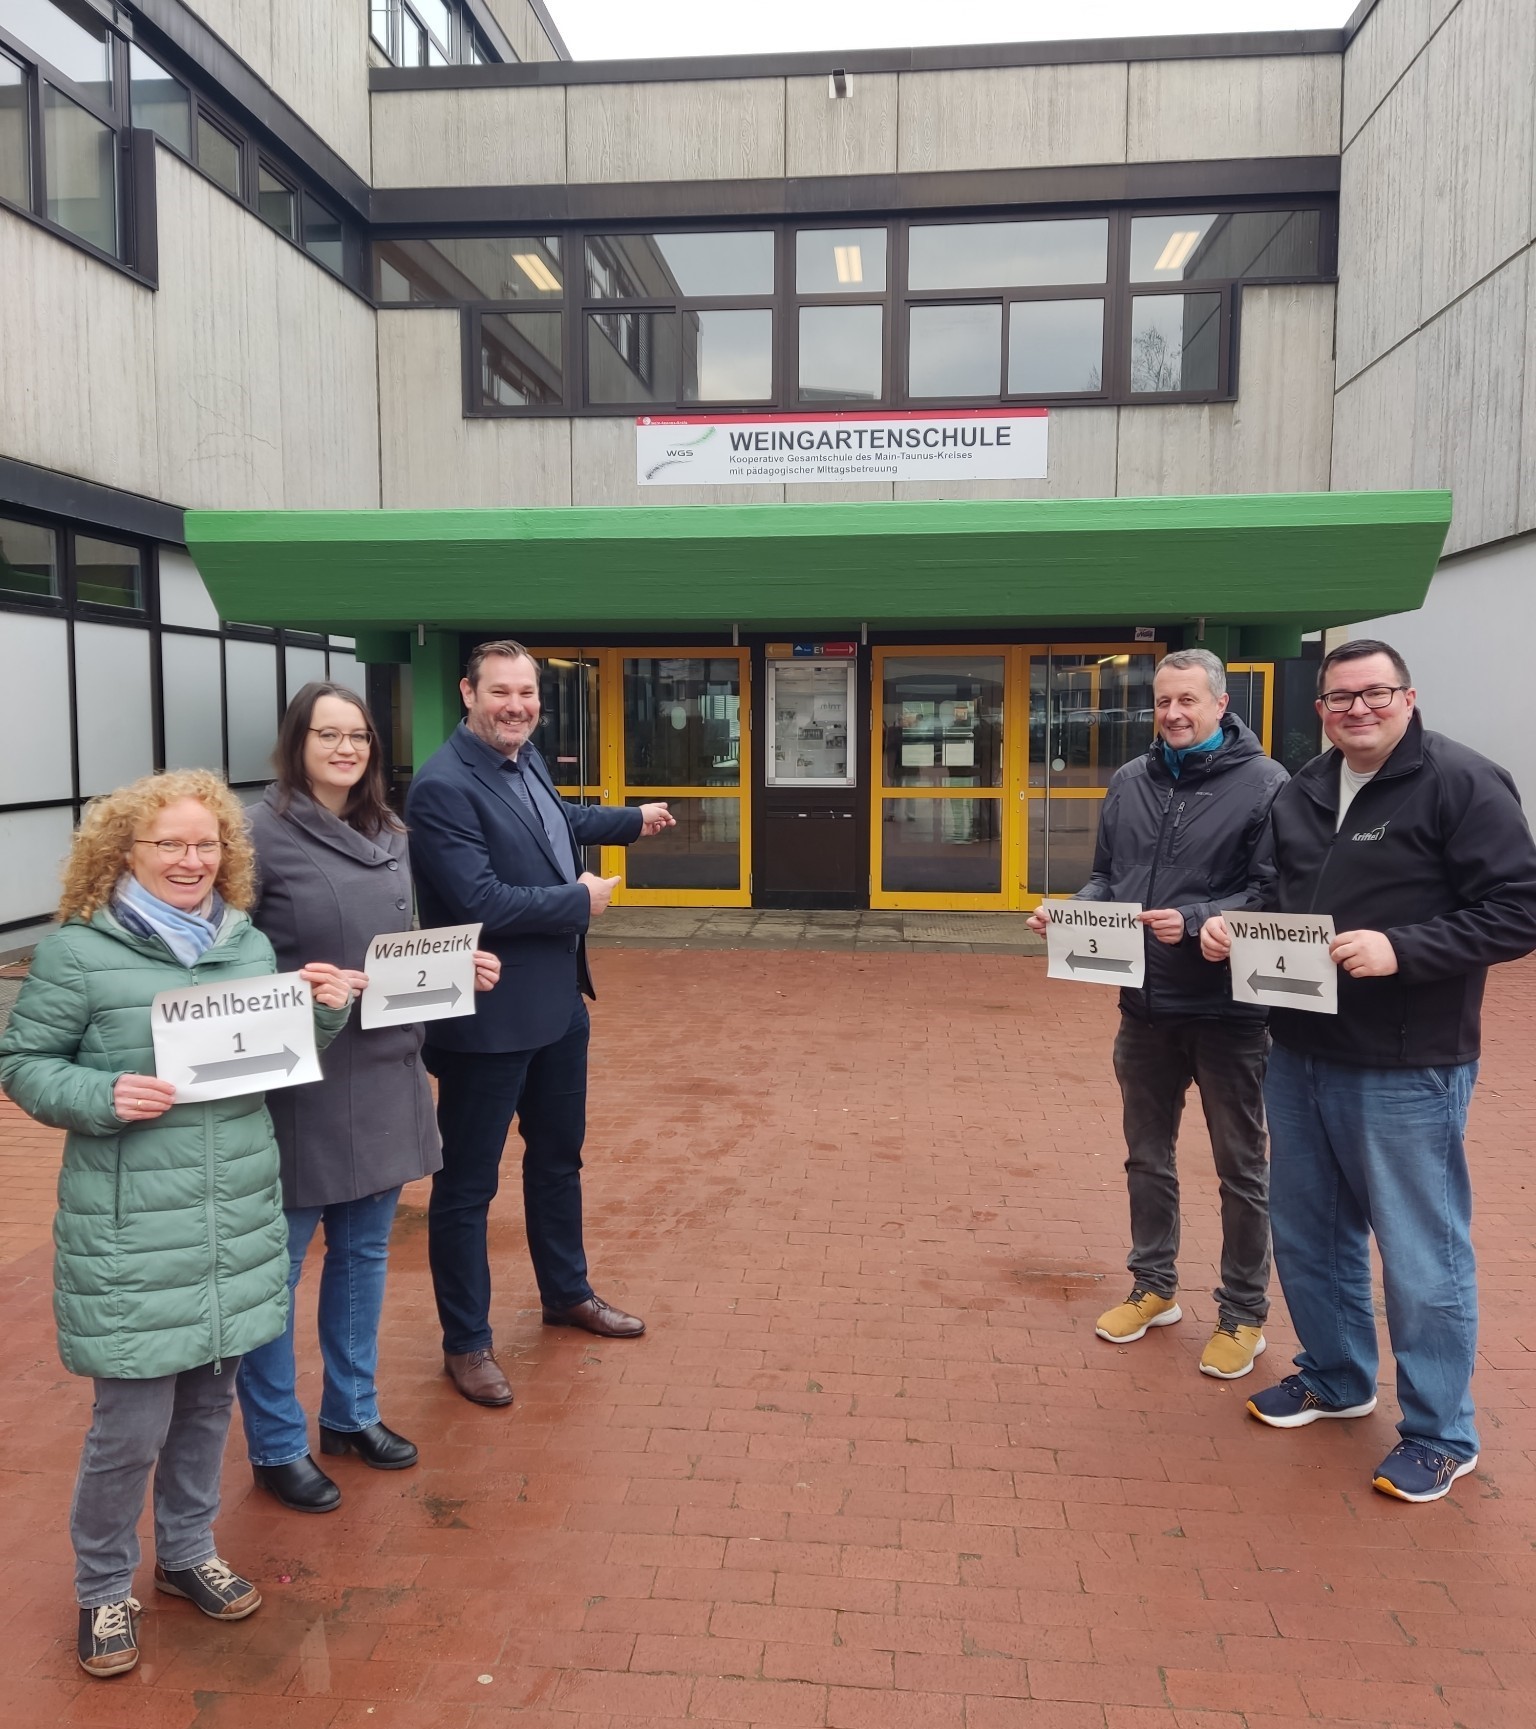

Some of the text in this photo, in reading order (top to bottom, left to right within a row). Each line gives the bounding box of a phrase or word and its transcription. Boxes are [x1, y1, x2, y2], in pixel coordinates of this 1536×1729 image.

[729, 426, 1011, 451] WEINGARTENSCHULE
[666, 449, 694, 457] WGS
[729, 451, 973, 464] Kooperative Gesamtschule des Main-Taunus-Kreises
[729, 464, 898, 476] mit pädagogischer Mittagsbetreuung
[813, 646, 824, 654] E1
[1352, 831, 1380, 841] Kriftel
[1048, 908, 1138, 930] Wahlbezirk
[1230, 921, 1330, 945] Wahlbezirk
[374, 934, 472, 960] Wahlbezirk
[1088, 938, 1098, 954] 3
[1275, 955, 1286, 973] 4
[416, 970, 427, 987] 2
[161, 985, 305, 1024] Wahlbezirk
[232, 1032, 246, 1053] 1
